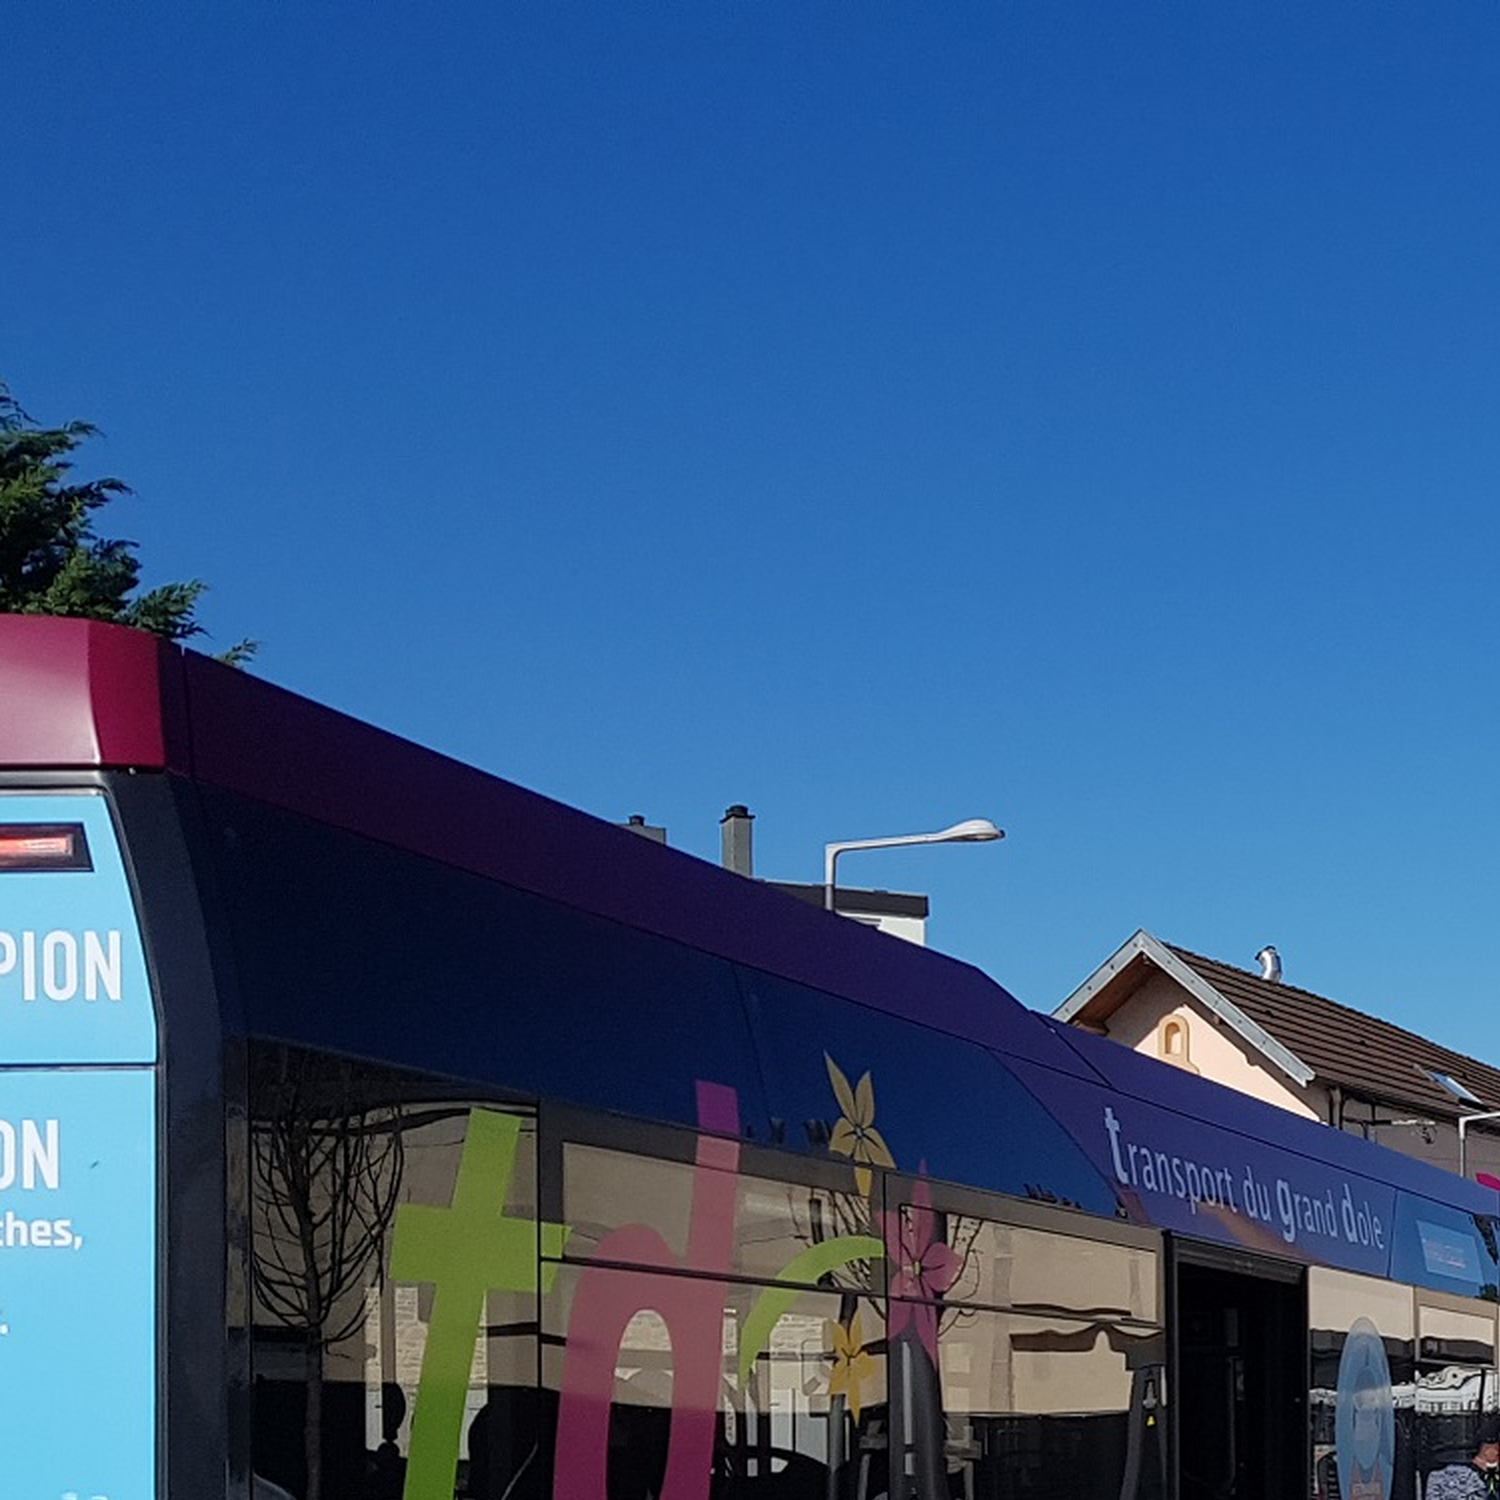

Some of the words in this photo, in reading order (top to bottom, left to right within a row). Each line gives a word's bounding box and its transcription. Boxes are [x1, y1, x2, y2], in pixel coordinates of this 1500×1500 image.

[1105, 1107, 1238, 1214] transport
[1243, 1166, 1272, 1222] du
[1276, 1179, 1338, 1243] grand
[1341, 1184, 1384, 1249] dole
